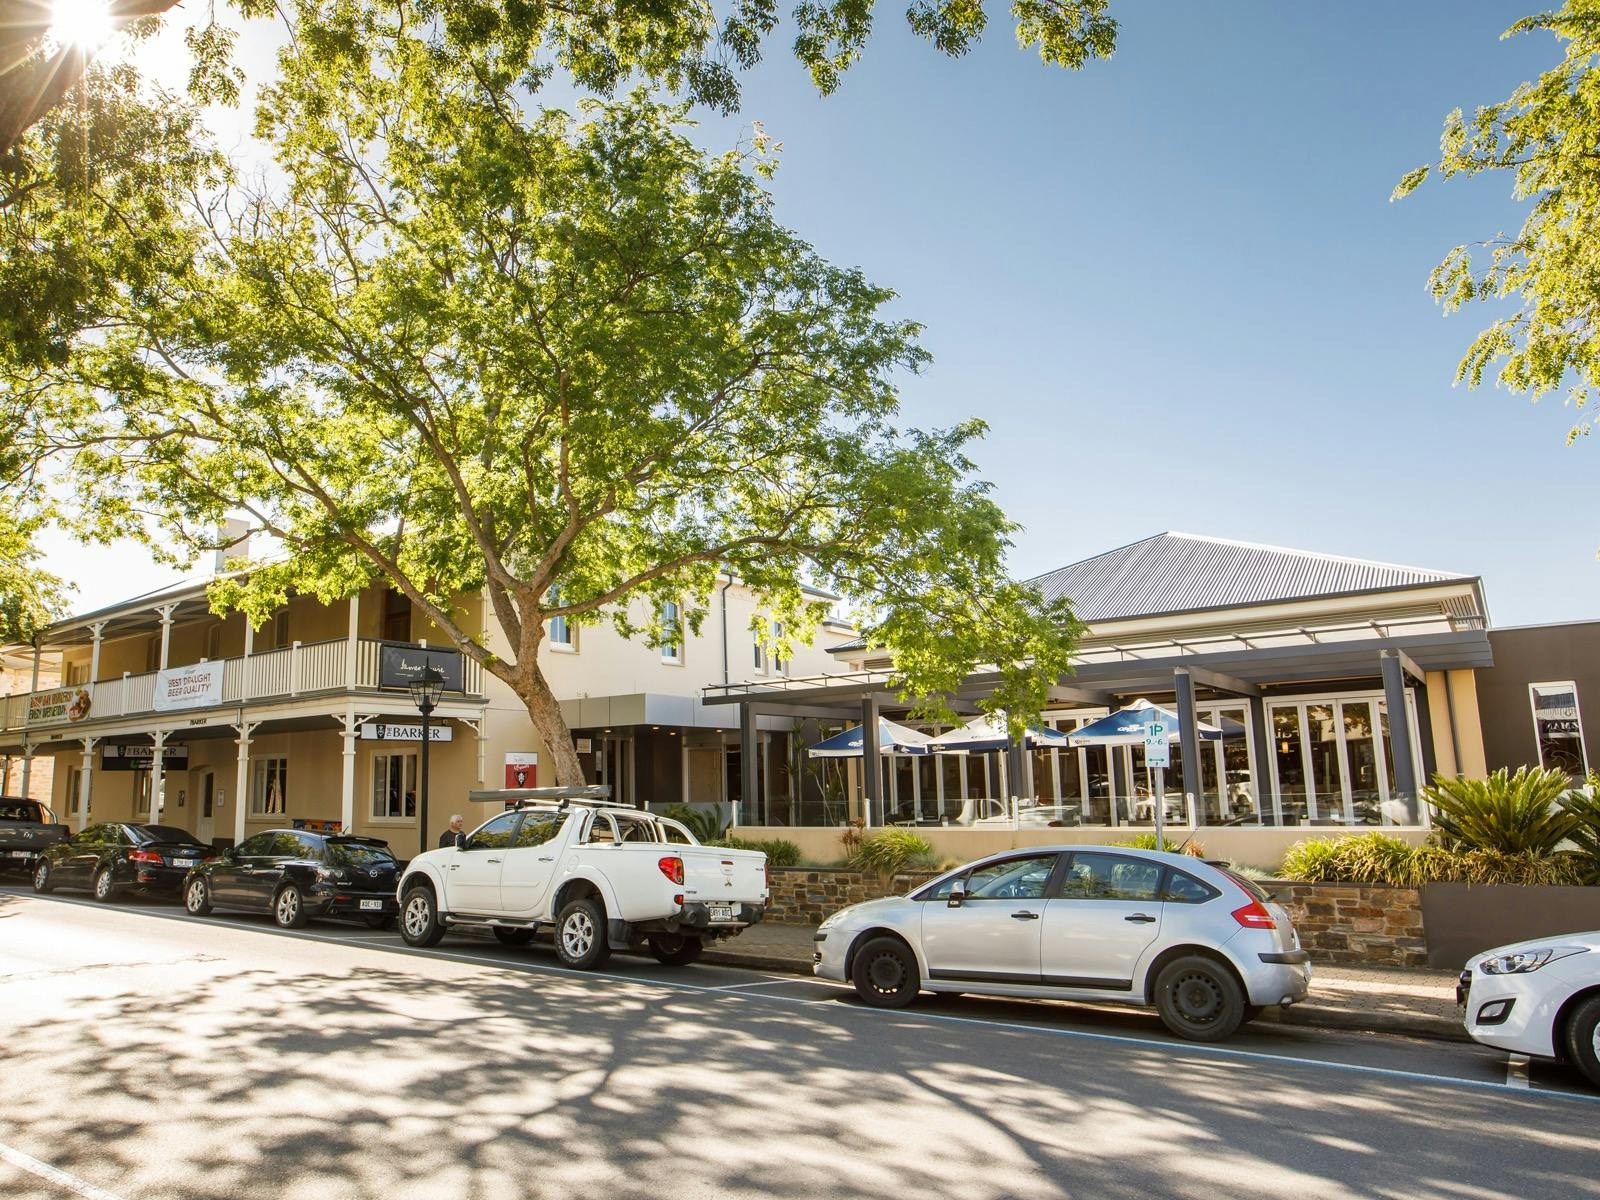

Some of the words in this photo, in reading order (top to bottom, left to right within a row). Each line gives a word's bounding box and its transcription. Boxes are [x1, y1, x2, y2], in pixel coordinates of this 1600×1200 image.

[168, 678, 182, 687] BEST
[183, 673, 211, 686] DRAUGHT
[168, 688, 182, 698] BEER
[1149, 724, 1163, 736] 1P
